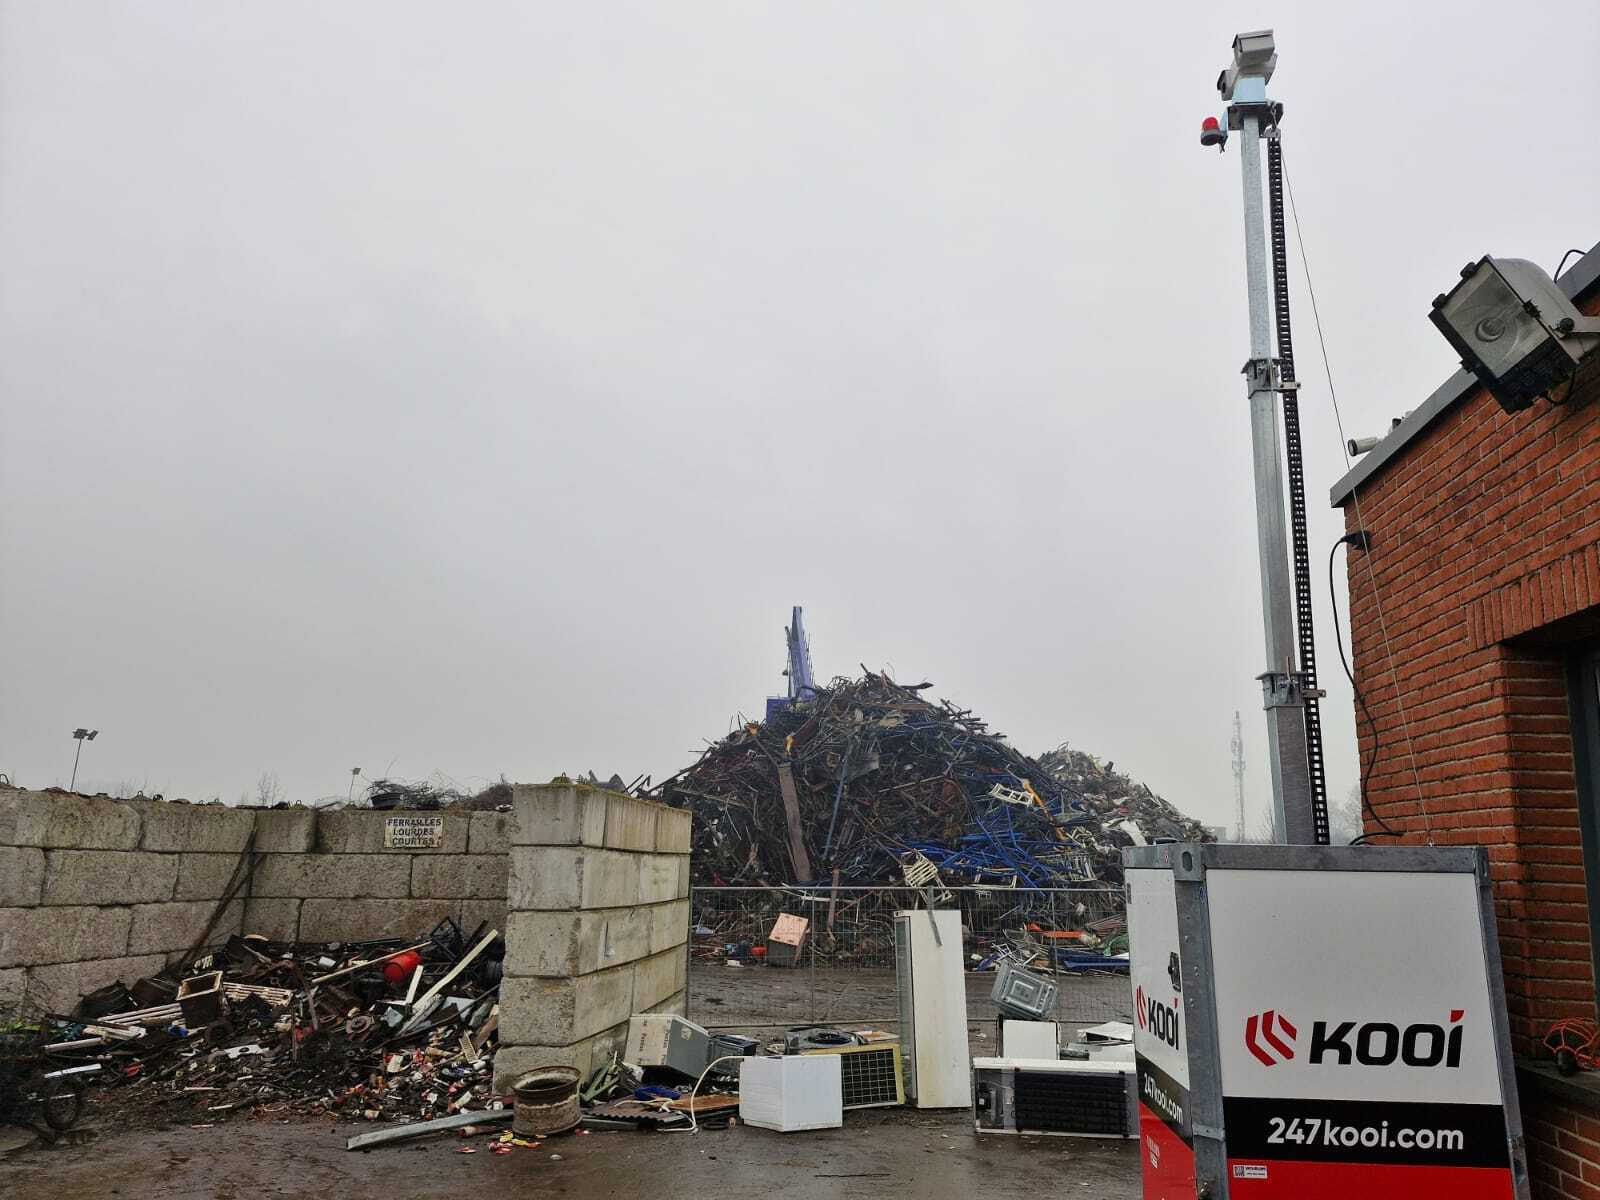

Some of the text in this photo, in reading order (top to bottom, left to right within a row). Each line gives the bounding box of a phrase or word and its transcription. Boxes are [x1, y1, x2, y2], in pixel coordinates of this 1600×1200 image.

[387, 818, 442, 827] FERRAILLES
[393, 828, 434, 836] LOURDES
[392, 837, 434, 846] COURTES
[1144, 1072, 1184, 1125] 247kooi.com
[1267, 1117, 1464, 1150] 247kooi.com
